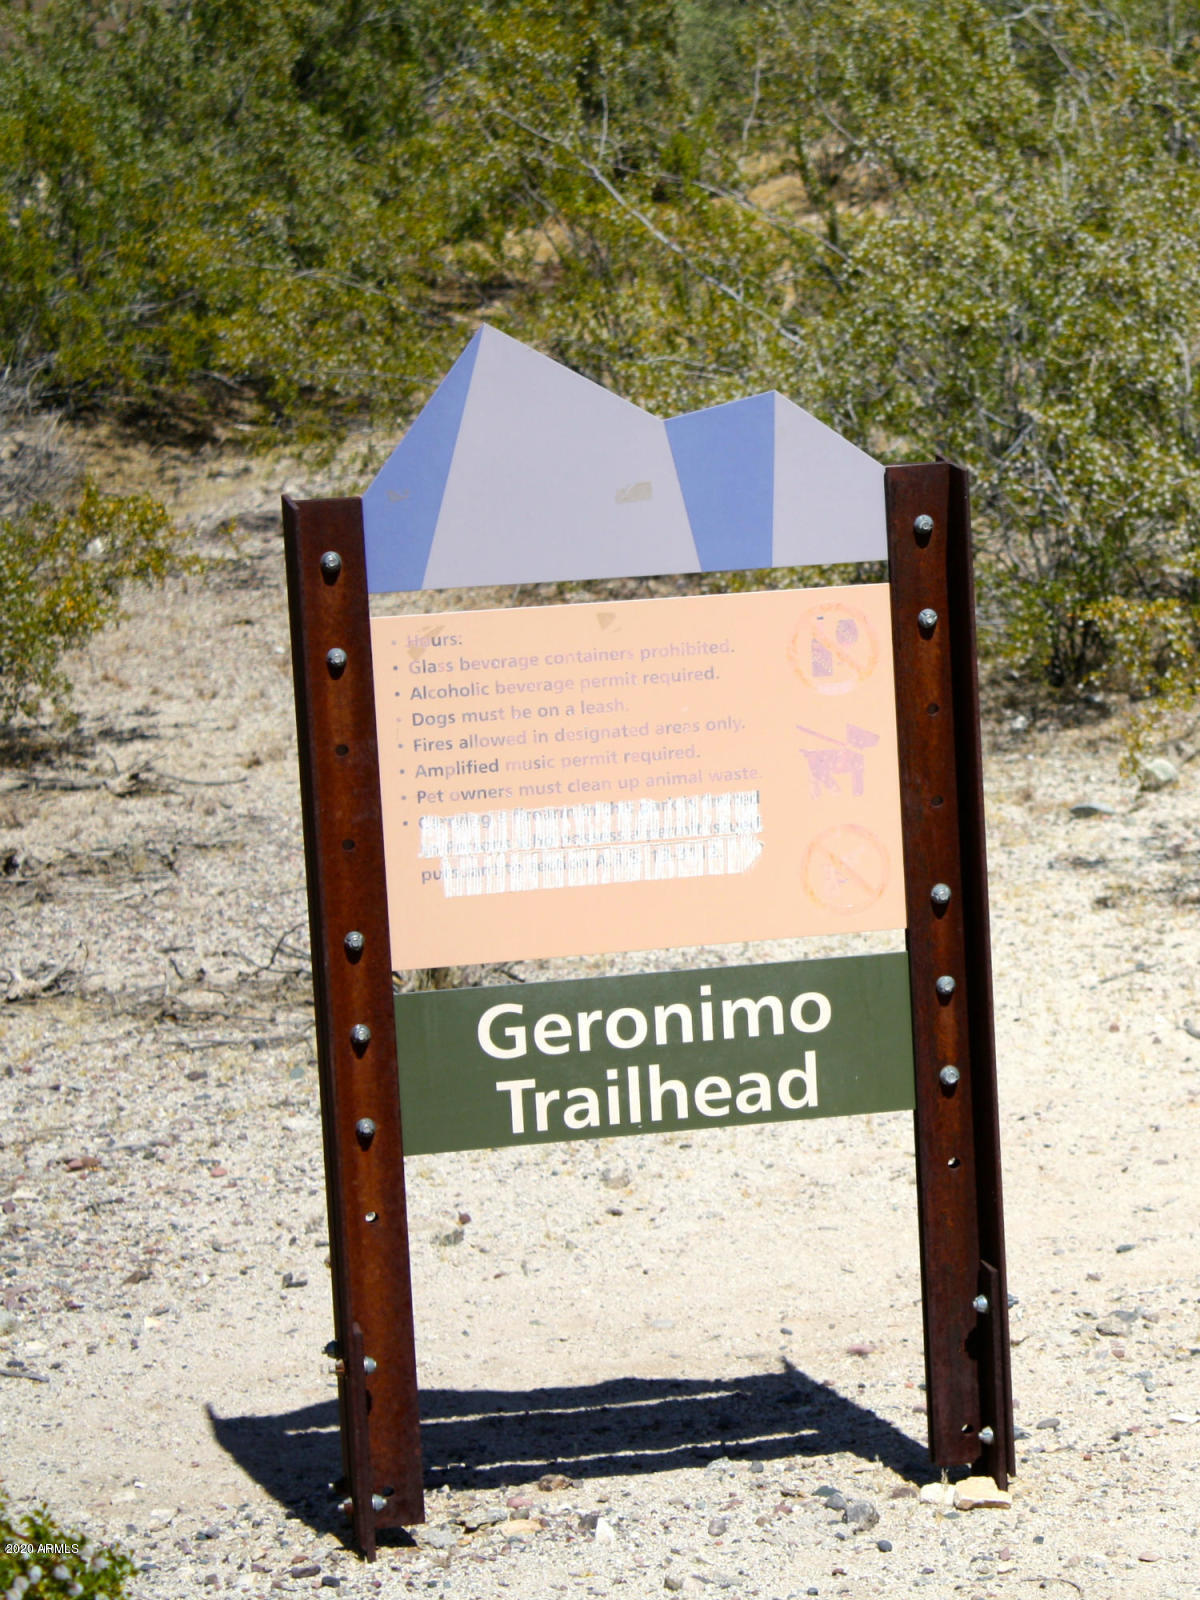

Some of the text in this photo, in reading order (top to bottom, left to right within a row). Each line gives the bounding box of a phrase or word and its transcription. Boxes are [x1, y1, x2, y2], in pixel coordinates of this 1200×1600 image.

[407, 634, 463, 648] Hours:
[409, 639, 734, 674] Glass beverage containers prohibited.
[410, 666, 719, 700] Alcoholic beverage permit required.
[412, 699, 629, 728] Dogs must be on a leash.
[413, 716, 745, 752] Fires allowed in designated areas only.
[415, 745, 700, 780] Amplified music permit required.
[416, 768, 764, 804] Pet owners must clean up animal waste.
[477, 984, 832, 1060] Geronimo
[495, 1050, 819, 1134] Trailhead
